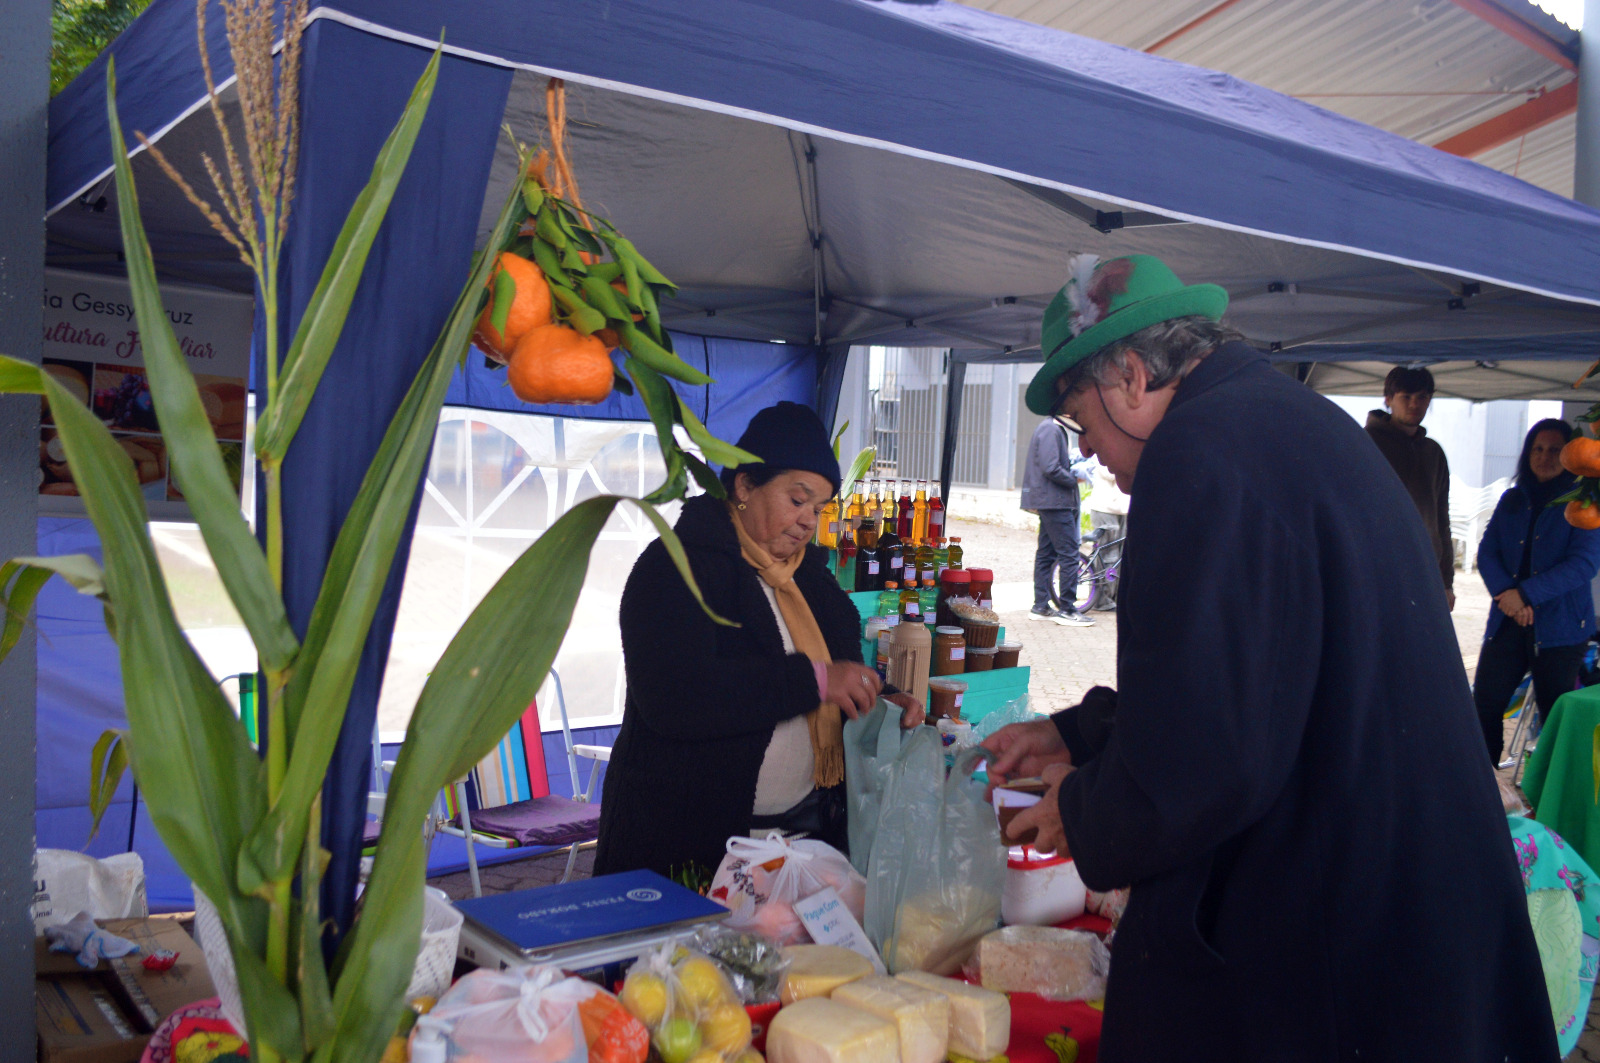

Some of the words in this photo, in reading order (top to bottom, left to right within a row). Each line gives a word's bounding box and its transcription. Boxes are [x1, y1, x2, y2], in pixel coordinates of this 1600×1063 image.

[43, 288, 62, 308] ia
[72, 292, 136, 322] Gessy
[42, 321, 108, 348] ultura
[115, 330, 216, 359] Fliar
